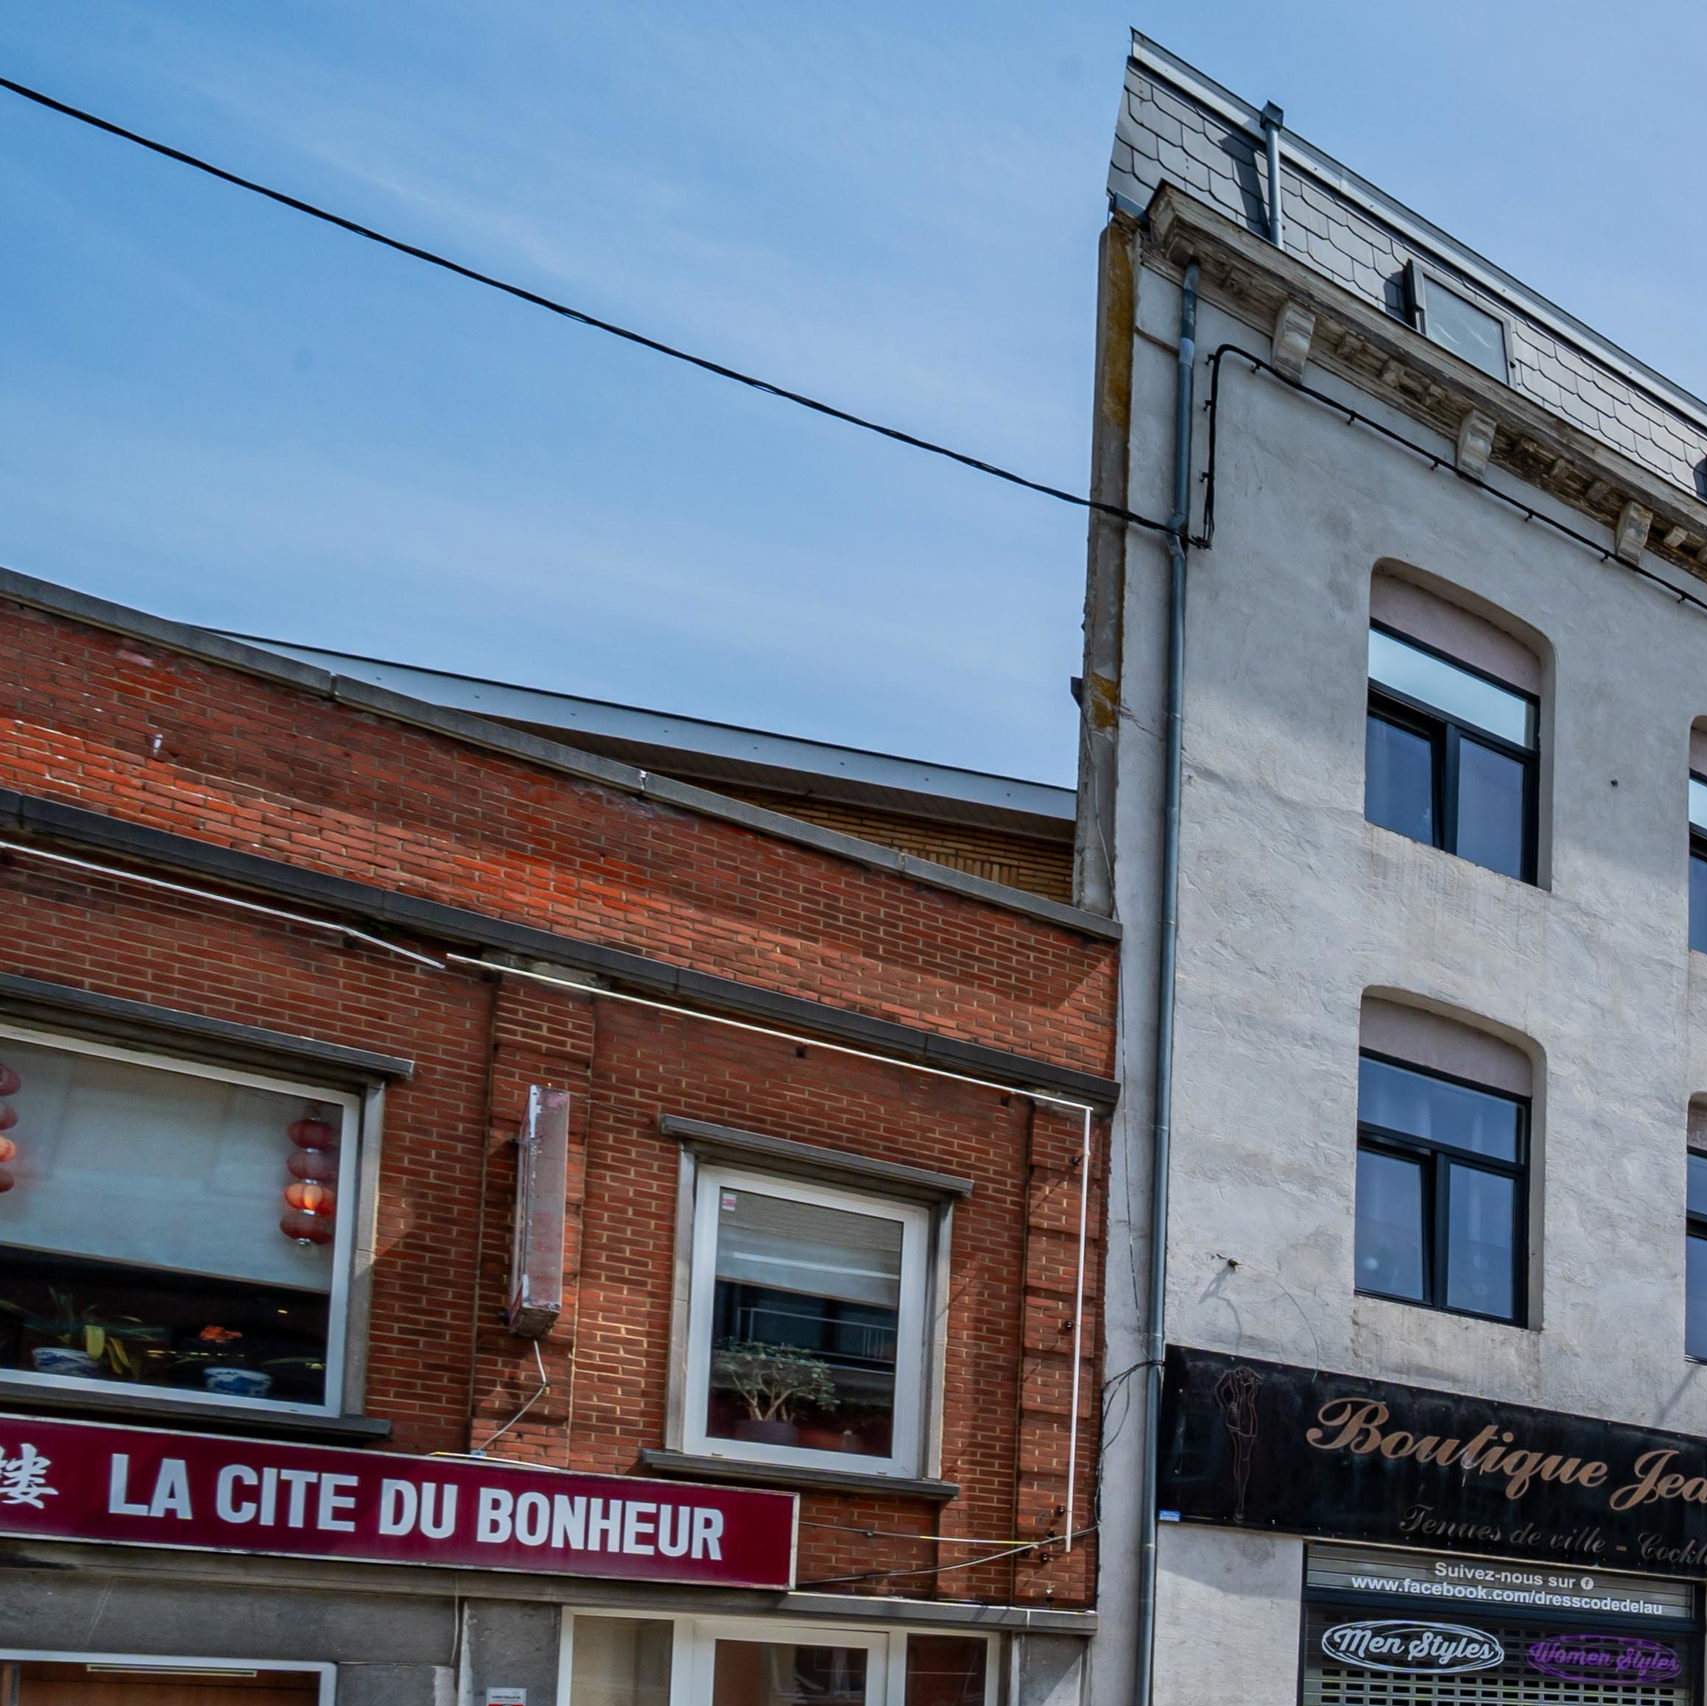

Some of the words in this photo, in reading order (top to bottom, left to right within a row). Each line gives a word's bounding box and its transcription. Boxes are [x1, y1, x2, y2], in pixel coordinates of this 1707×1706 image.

[1306, 1397, 1608, 1500] Boutique
[108, 1453, 193, 1520] LA
[216, 1464, 359, 1533] CITE
[378, 1478, 459, 1540] DU
[476, 1486, 724, 1561] BONHEUR
[1400, 1503, 1501, 1542] Tenues
[1509, 1522, 1541, 1546] de
[1550, 1526, 1606, 1553] ville
[1434, 1561, 1543, 1587] Suivez-nous
[1547, 1573, 1576, 1589] sur
[1351, 1576, 1663, 1615] www.facebook.com/dresscodedelau
[1333, 1628, 1405, 1658] Men
[1408, 1631, 1494, 1665] Styles
[1529, 1641, 1613, 1666] Women
[1615, 1647, 1680, 1676] Styles
